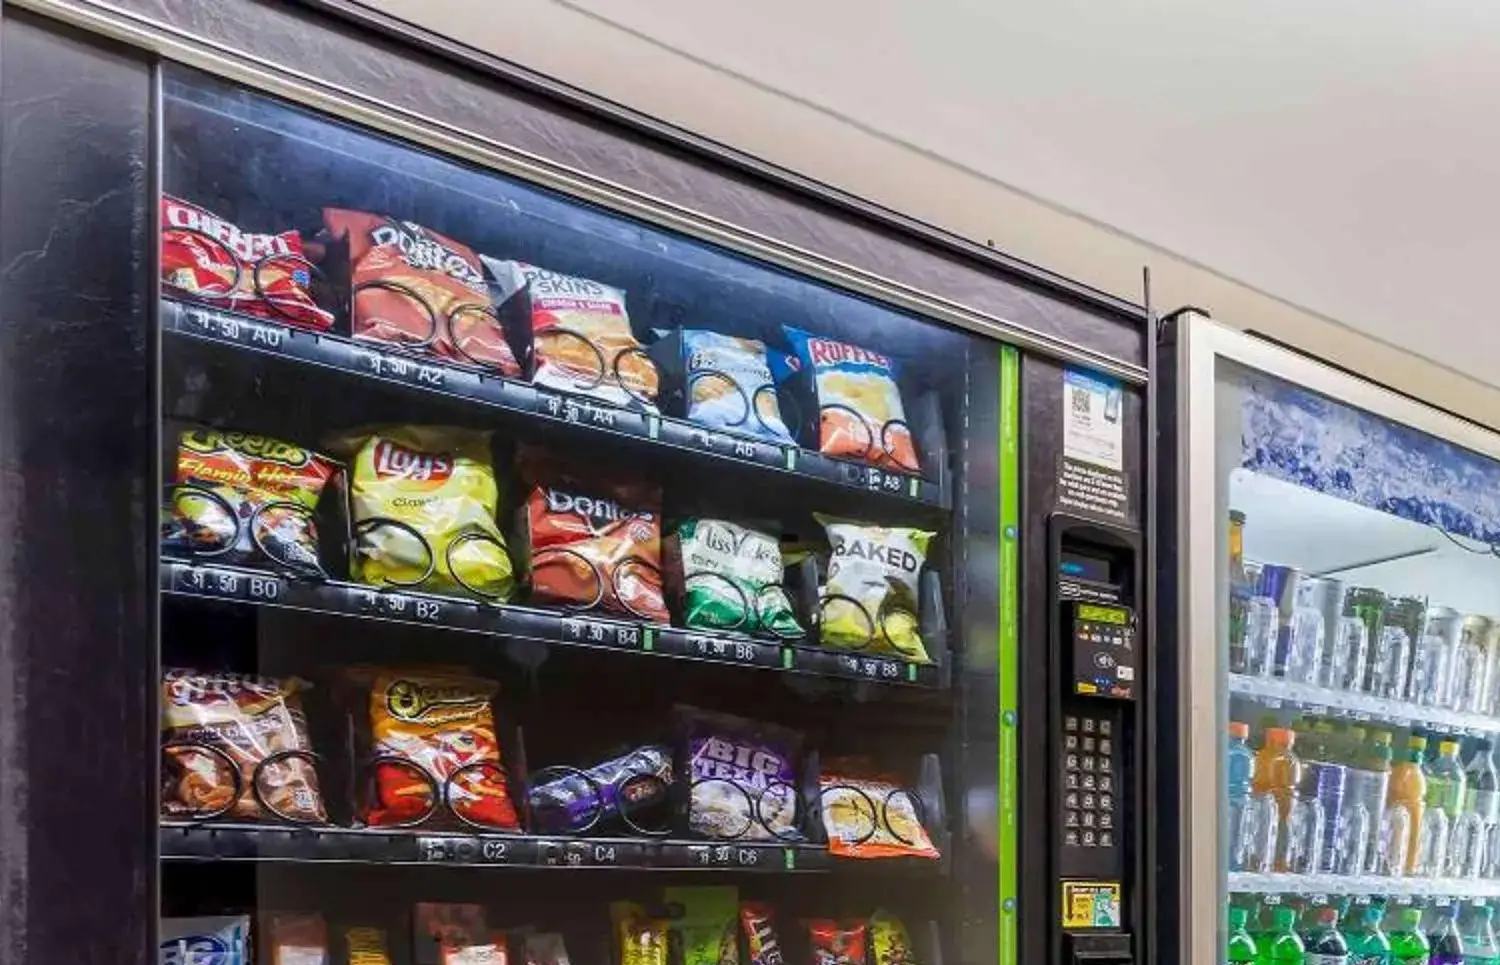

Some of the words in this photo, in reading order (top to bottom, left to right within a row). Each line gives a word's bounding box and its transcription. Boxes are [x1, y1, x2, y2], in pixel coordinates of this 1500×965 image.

[538, 278, 605, 298] SKINS
[253, 327, 281, 347] A0
[417, 366, 443, 386] A2
[834, 533, 918, 574] BAKED
[250, 577, 279, 598] B0
[416, 600, 440, 619] B2
[617, 629, 638, 645] B4
[735, 645, 754, 661] B6
[708, 736, 783, 775] BIG
[697, 758, 789, 796] TEXAS
[483, 840, 506, 859] C2
[594, 846, 615, 862] C4
[739, 848, 757, 864] C6
